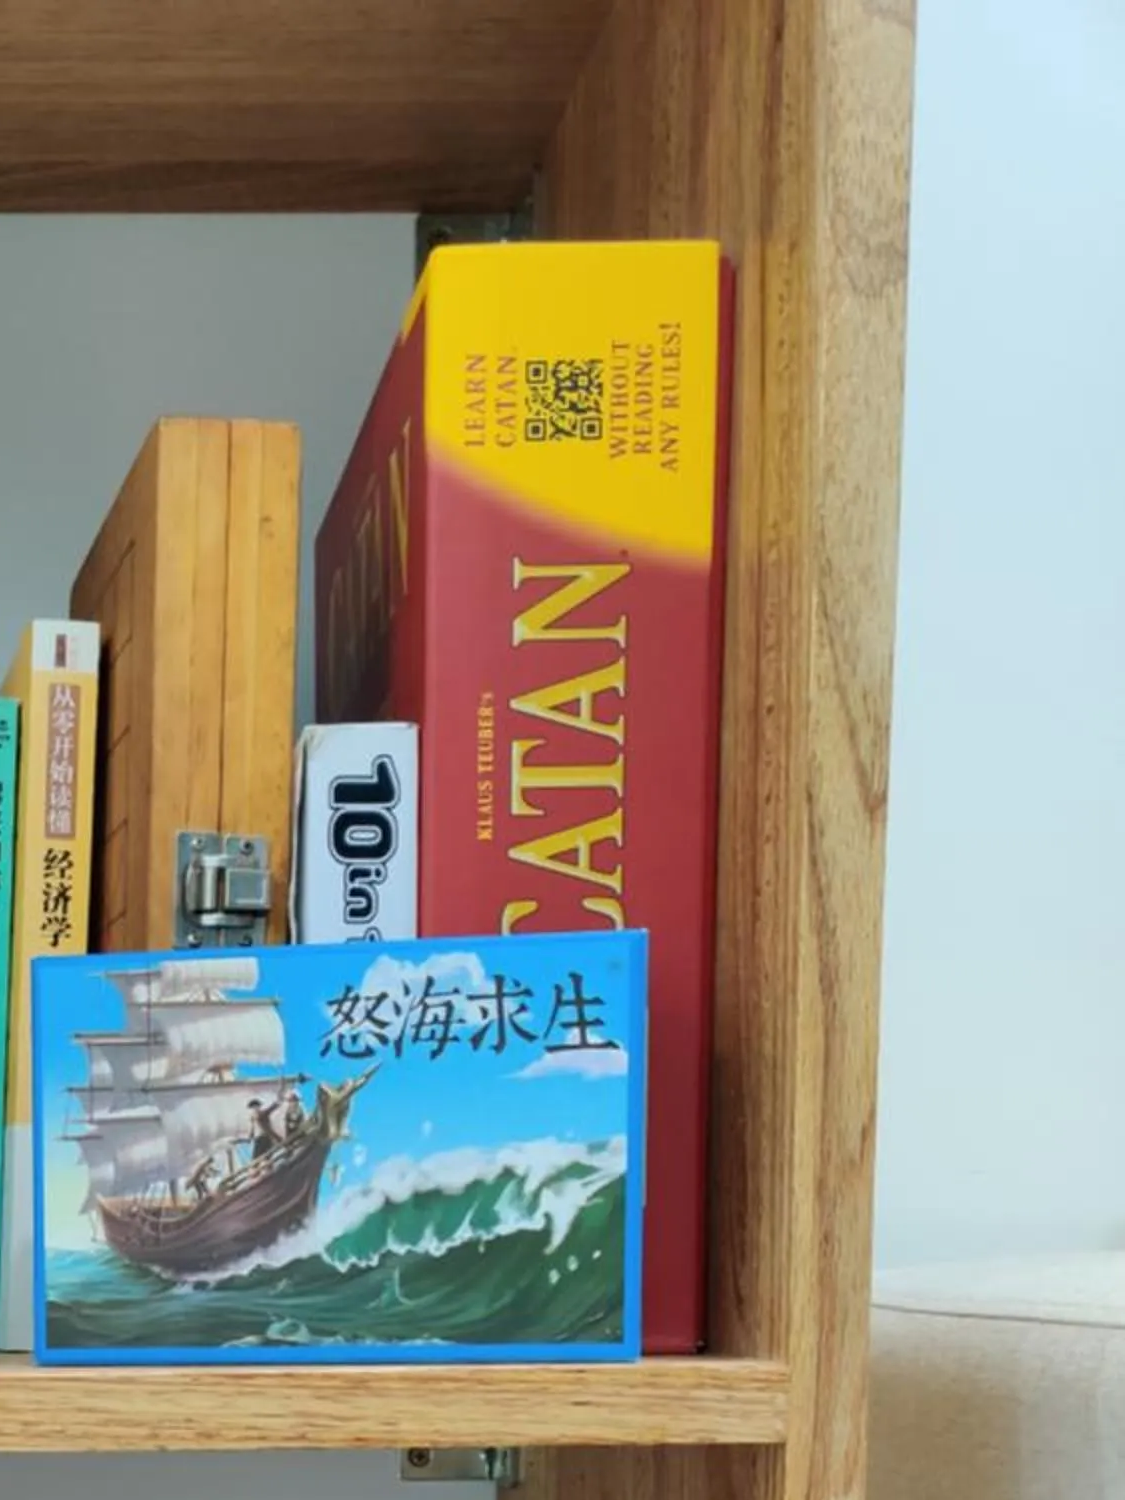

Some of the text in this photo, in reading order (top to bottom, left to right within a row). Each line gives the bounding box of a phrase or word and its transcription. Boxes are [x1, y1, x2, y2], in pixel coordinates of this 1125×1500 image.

[464, 353, 487, 448] LEARN
[494, 355, 518, 448] CATAN
[609, 340, 630, 460] WITHOUT
[633, 343, 654, 454] READING
[659, 322, 682, 472] ANY RULES!
[40, 847, 74, 948] 经济学
[320, 971, 621, 1061] 怒海求生
